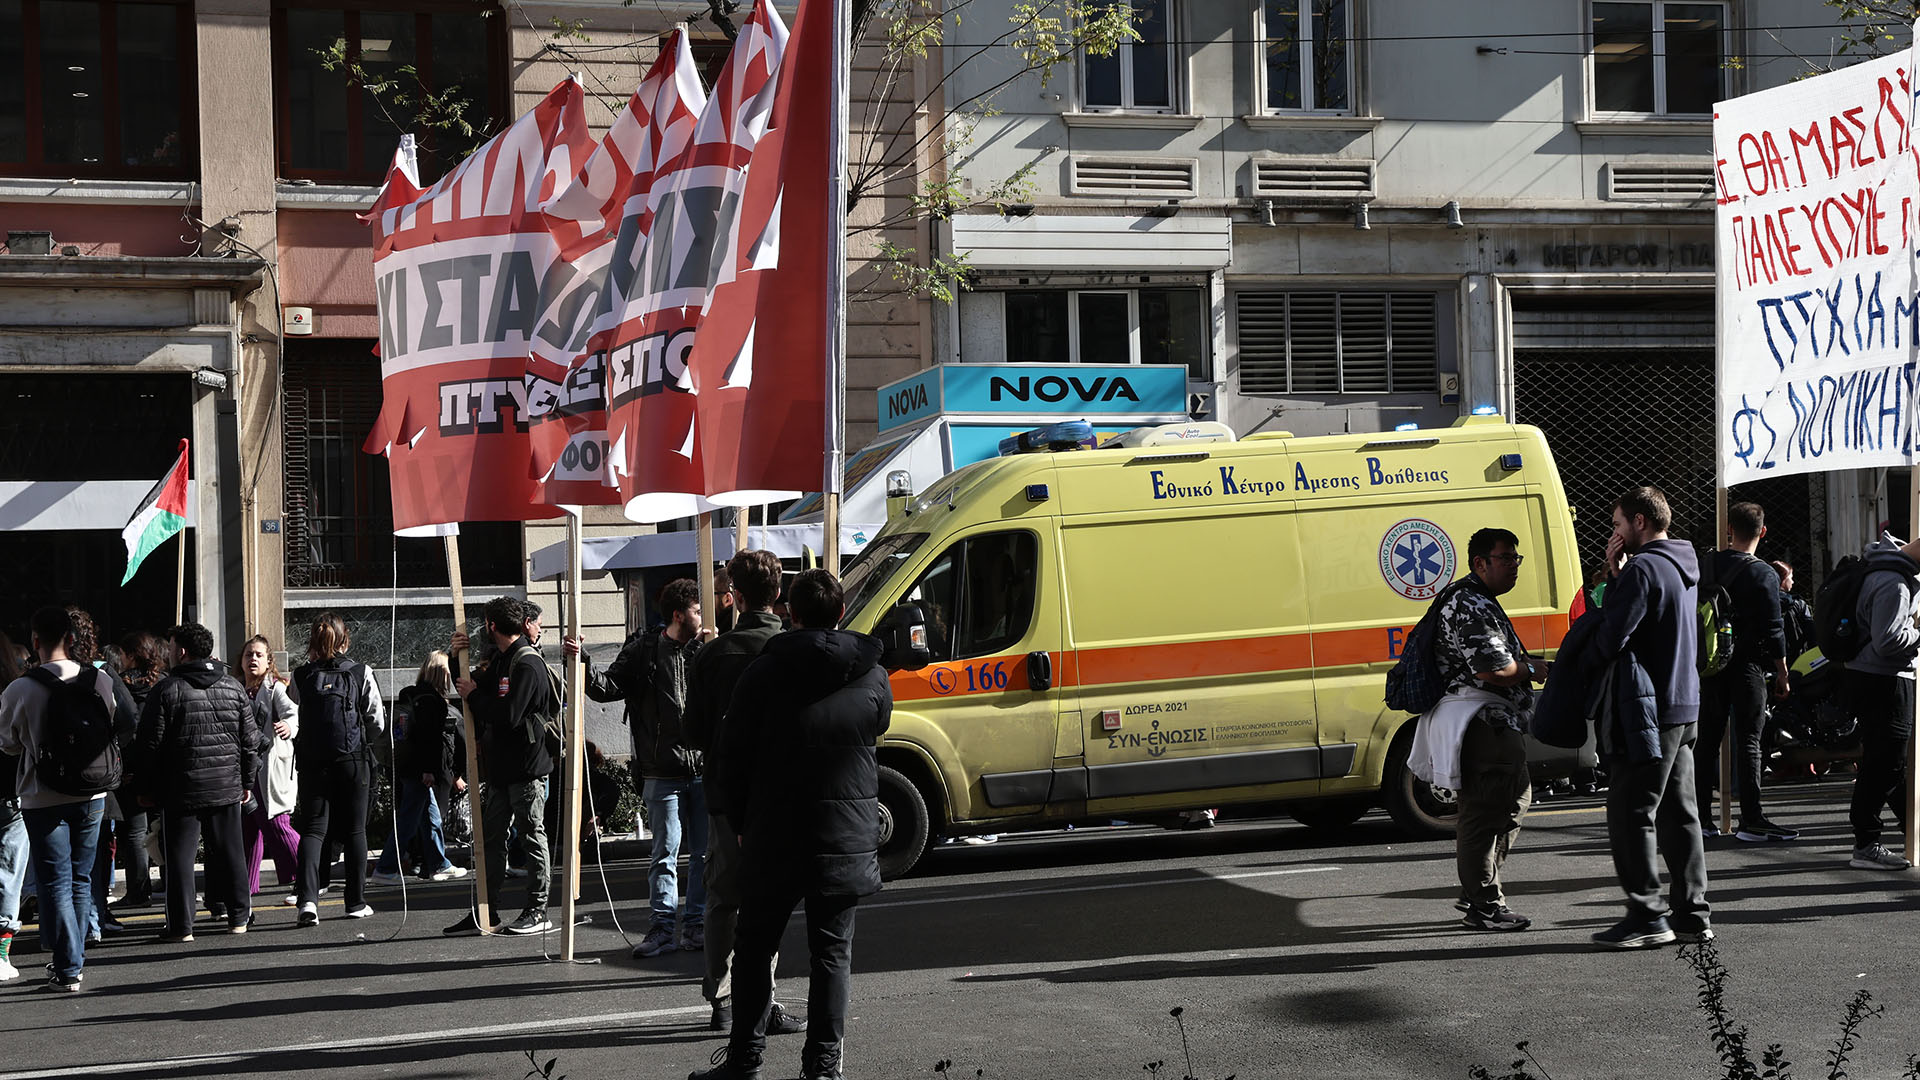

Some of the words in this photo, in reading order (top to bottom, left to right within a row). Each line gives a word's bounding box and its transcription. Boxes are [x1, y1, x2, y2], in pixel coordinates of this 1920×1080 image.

[889, 383, 929, 420] NOVA
[990, 376, 1141, 402] NOVA
[1150, 470, 1213, 500] Εθνικό
[1219, 466, 1285, 496] Κέντρο
[1294, 461, 1360, 493] Αμεσης
[1366, 457, 1449, 486] Βοήθειας
[265, 522, 276, 531] 36
[1386, 524, 1409, 547] ΚΕΝΤΡΟ
[1410, 522, 1440, 537] ΑΜΕΣΗΣ
[1383, 549, 1395, 581] ΕΘΝΙΚΟ
[965, 661, 1008, 692] 166
[1125, 704, 1163, 715] ΔΩΡΕΑ
[1165, 702, 1188, 712] 2021
